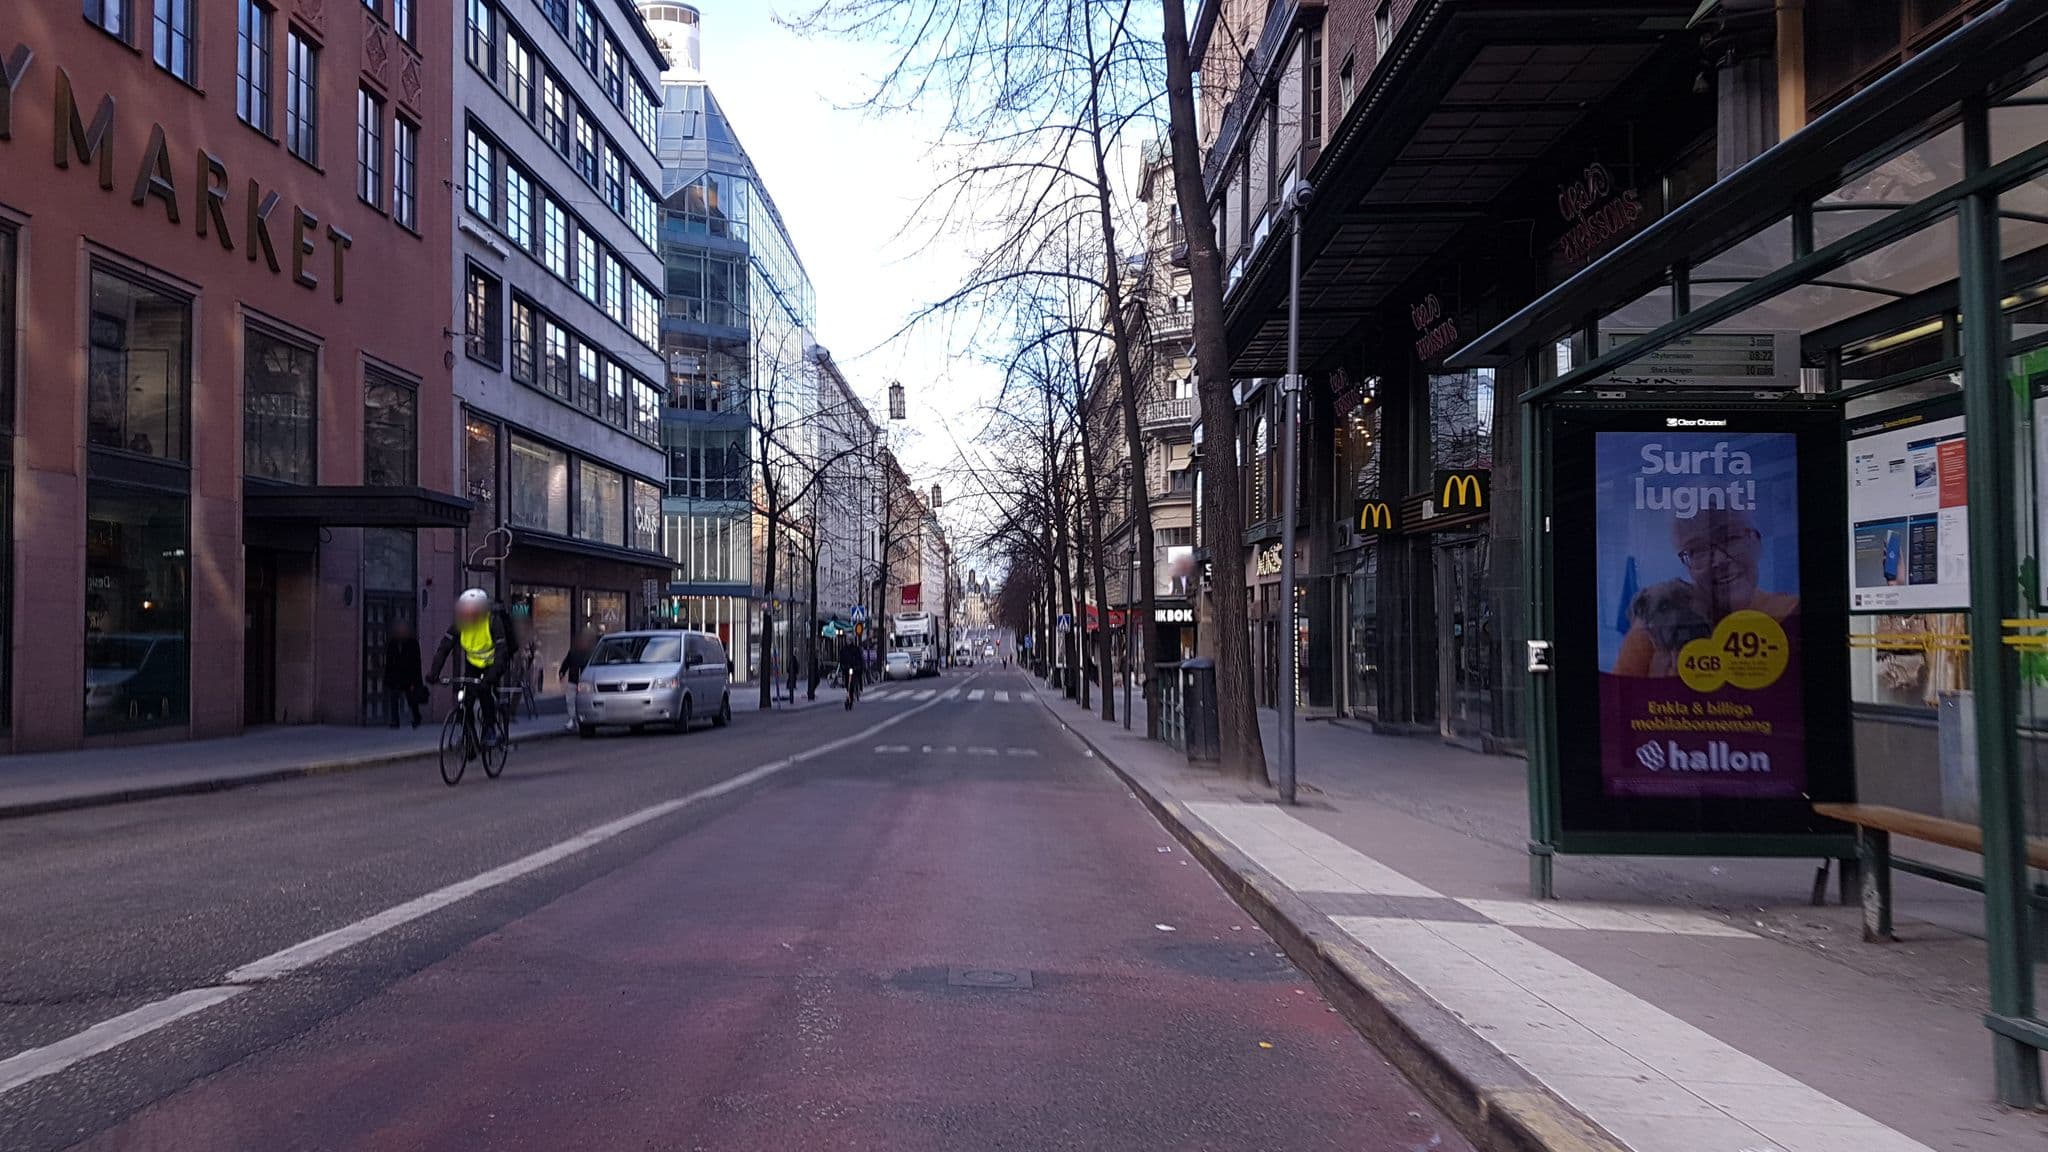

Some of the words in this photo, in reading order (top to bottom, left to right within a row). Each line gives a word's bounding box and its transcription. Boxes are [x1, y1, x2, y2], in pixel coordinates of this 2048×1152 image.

[1677, 418, 1697, 426] Clear
[1697, 418, 1727, 426] Channel
[1640, 442, 1752, 475] Surfa
[1635, 477, 1757, 519] lugnt!
[1723, 631, 1779, 658] 49:-
[1648, 701, 1689, 715] Enkla
[1692, 702, 1704, 715] &
[1707, 701, 1753, 718] billiga
[1631, 717, 1773, 735] mobilabonnemang
[1668, 740, 1772, 772] hallon
